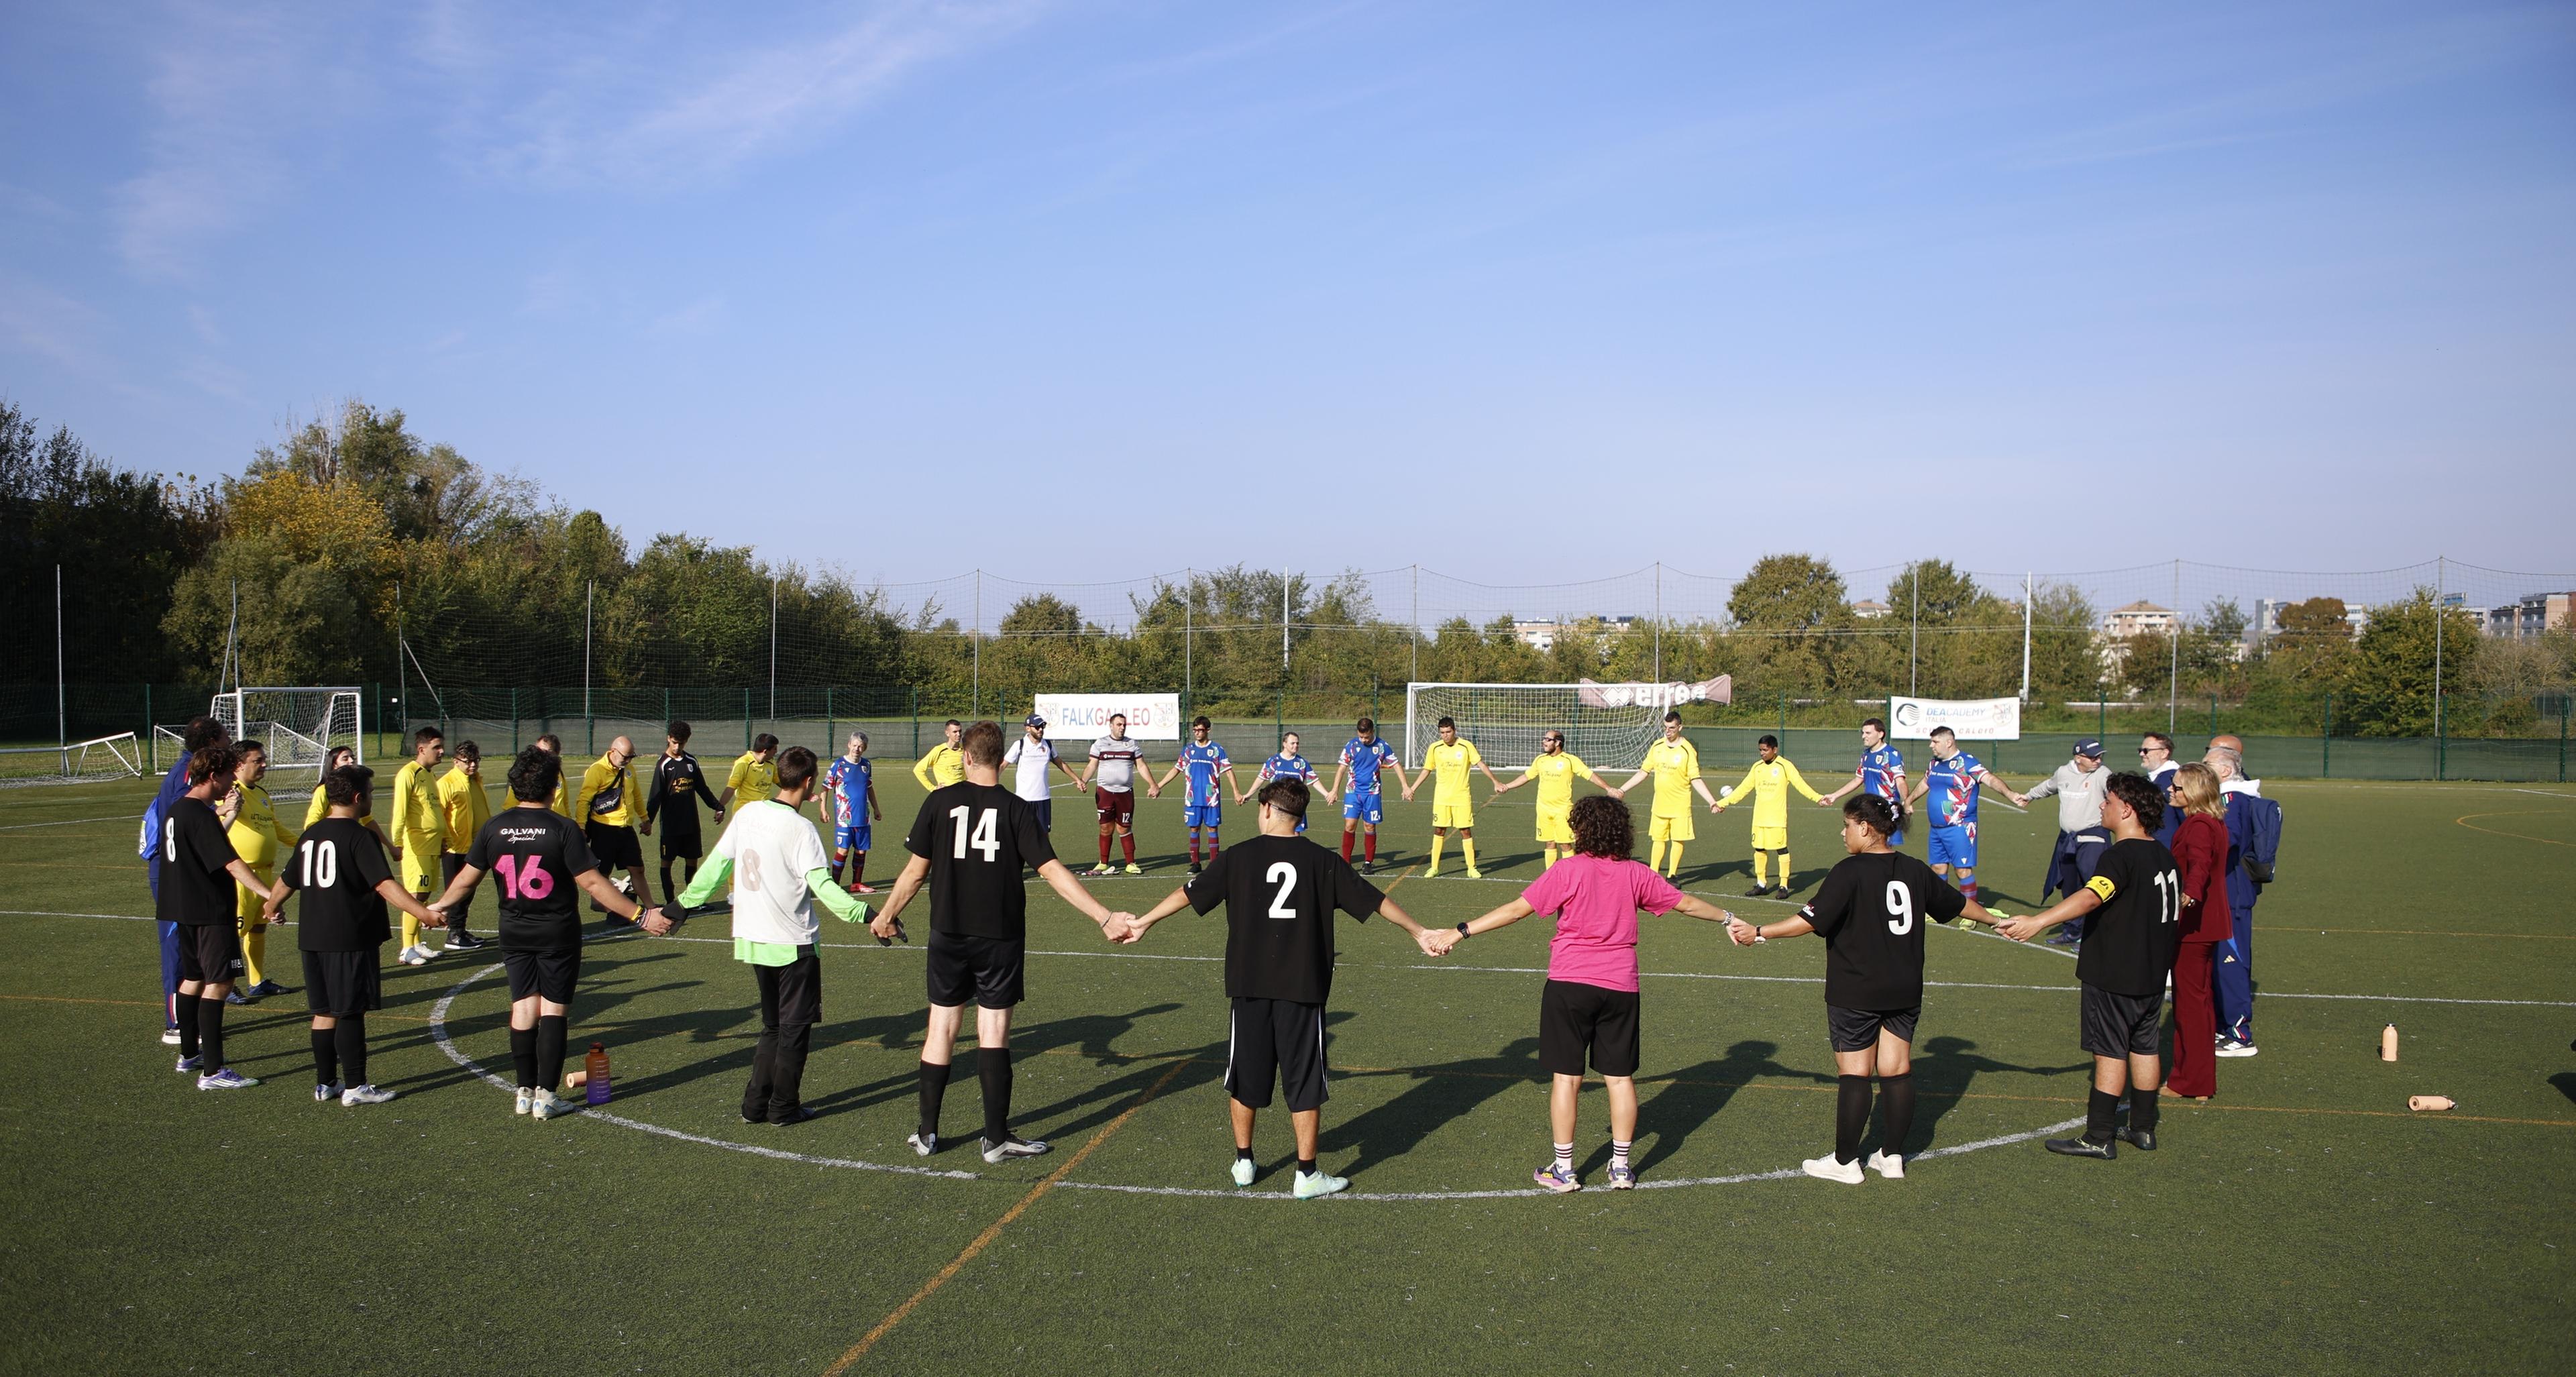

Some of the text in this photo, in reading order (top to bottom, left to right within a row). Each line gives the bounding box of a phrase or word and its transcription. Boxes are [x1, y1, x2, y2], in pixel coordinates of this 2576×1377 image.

[1927, 708, 1986, 716] DEACADEMY
[950, 806, 1000, 862] 14
[1122, 812, 1130, 823] 12
[1370, 810, 1379, 822] 12
[166, 818, 176, 863] 8
[508, 834, 536, 844] Special
[301, 840, 337, 887] 10
[419, 875, 429, 887] 10
[494, 854, 553, 899] 16
[741, 848, 761, 891] 8
[1266, 862, 1297, 919] 2
[1886, 881, 1913, 936] 9
[2153, 869, 2180, 924] 11
